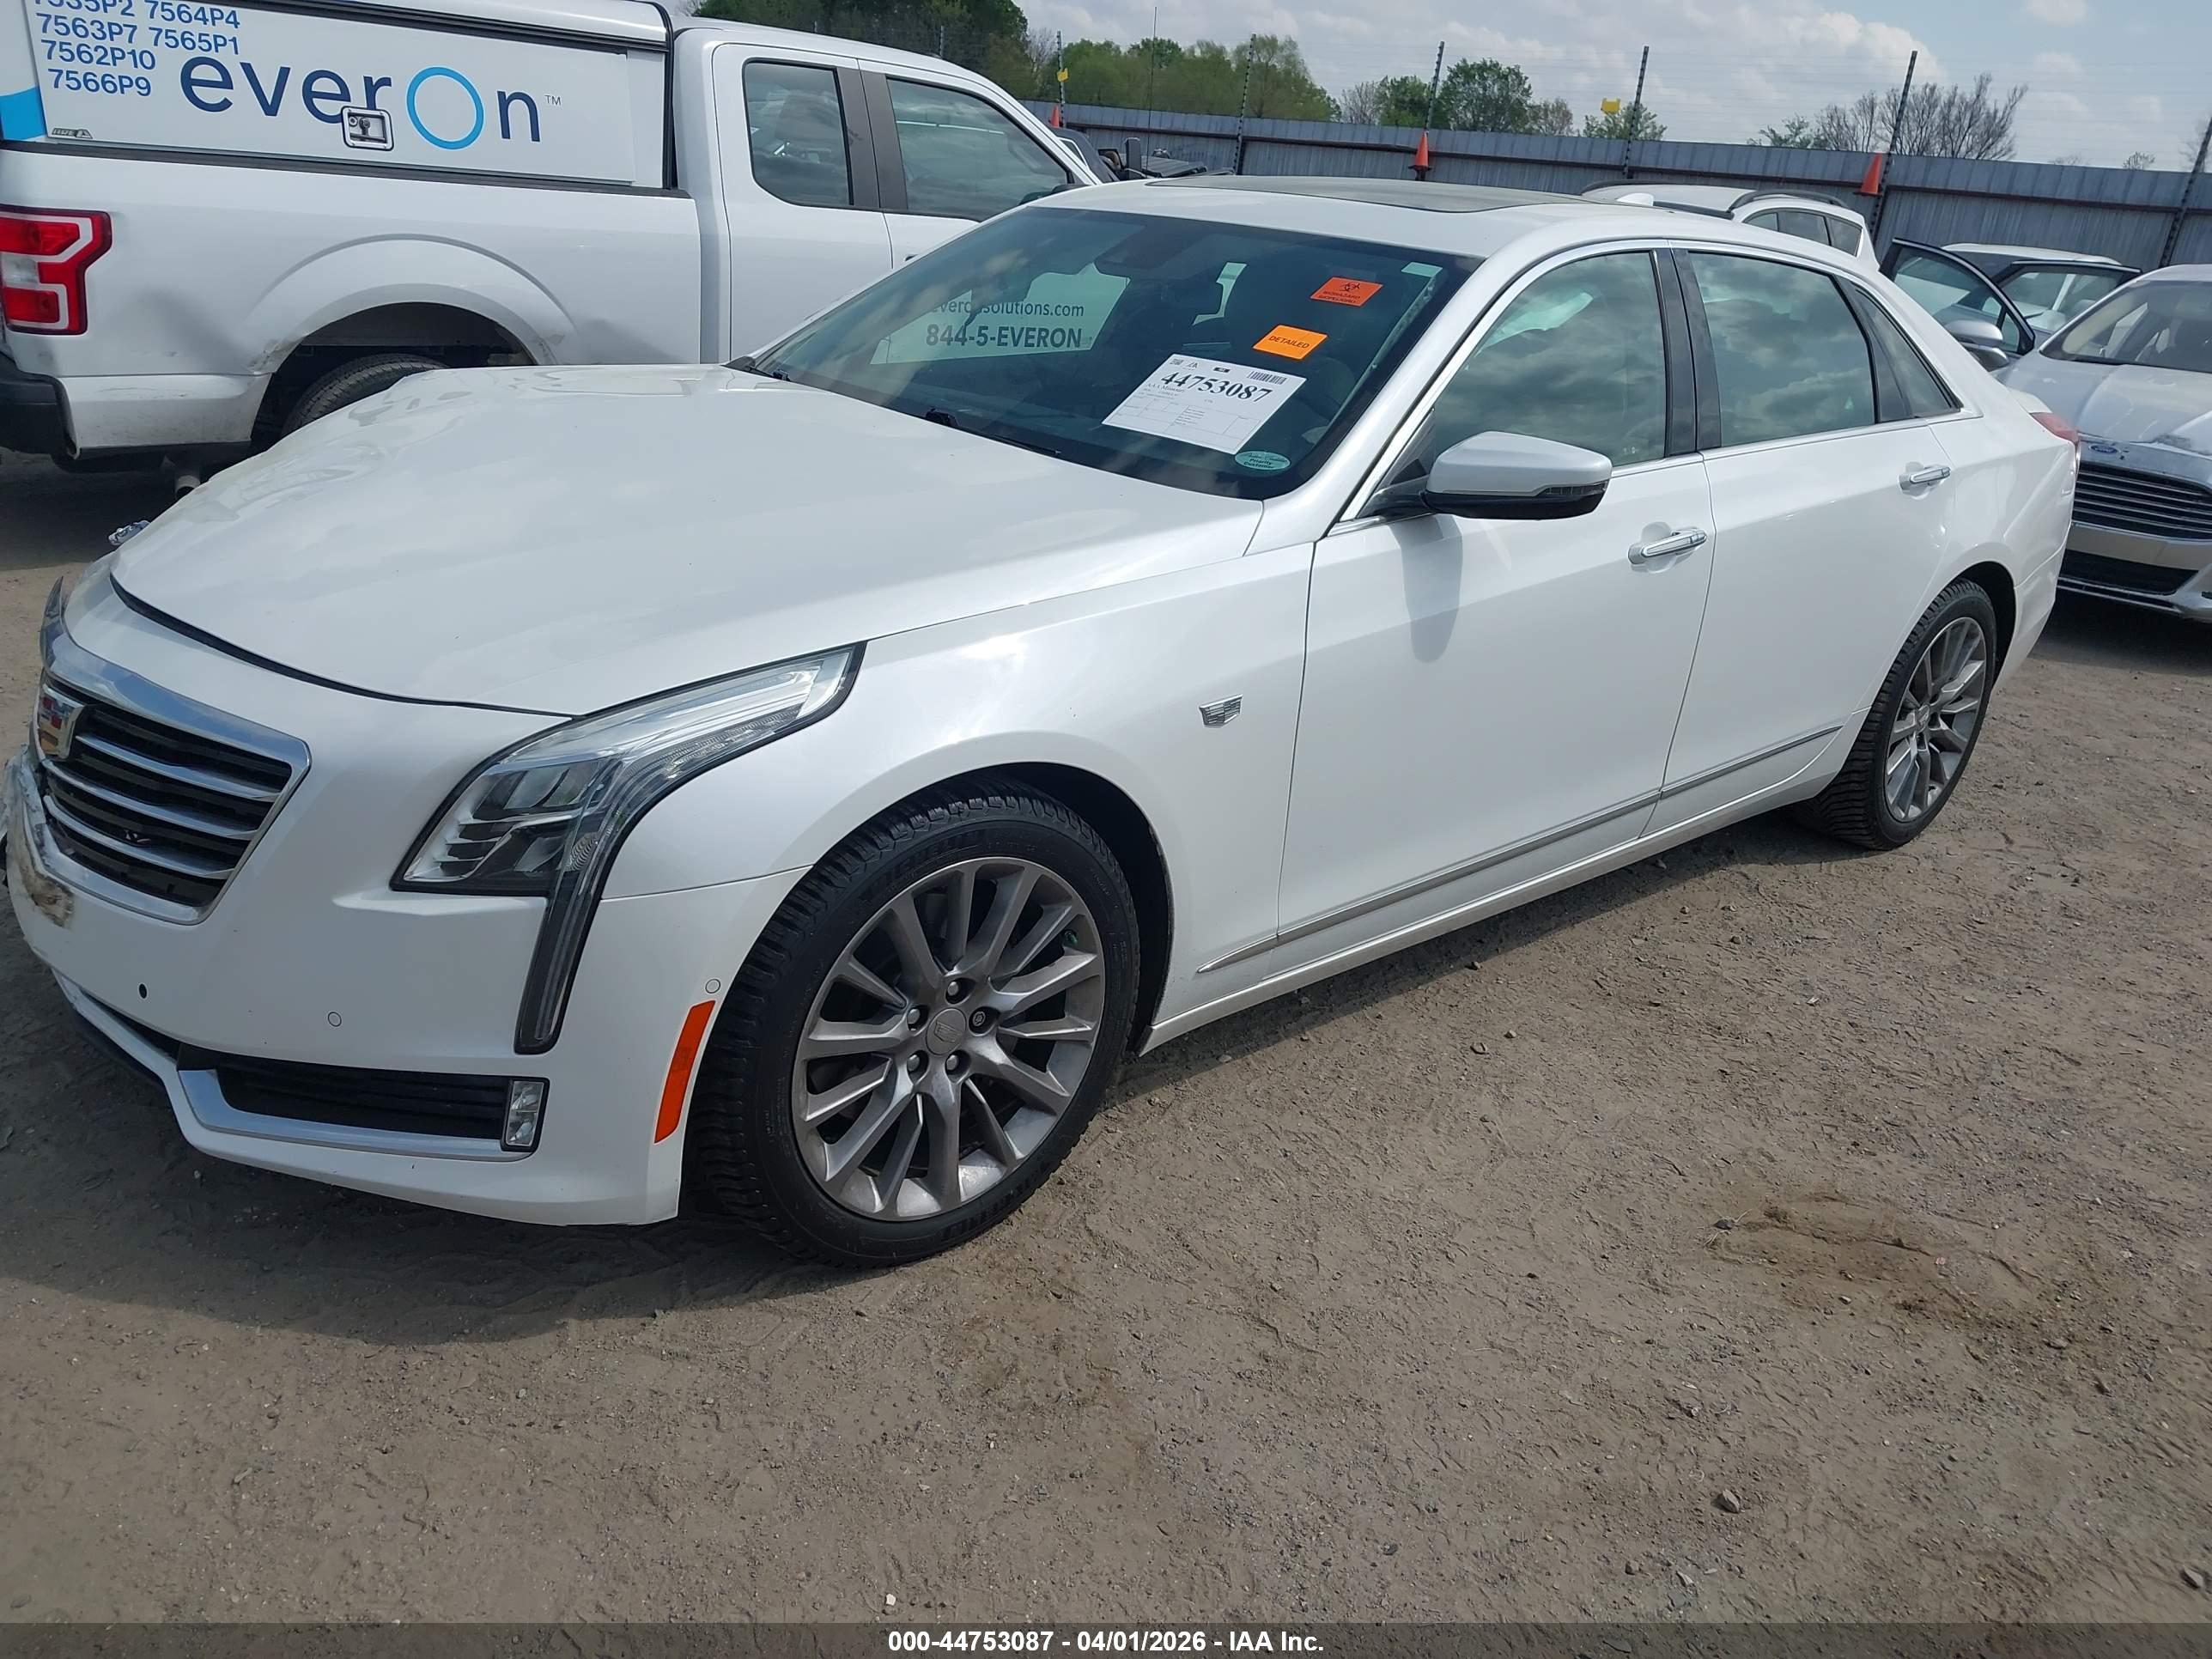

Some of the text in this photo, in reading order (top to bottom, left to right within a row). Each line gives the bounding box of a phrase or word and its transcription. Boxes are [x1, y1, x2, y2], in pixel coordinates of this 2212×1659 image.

[144, 0, 240, 28] 7564P4
[36, 12, 239, 55] 7563P7 7565P1
[41, 40, 156, 70] 7562P10
[48, 69, 151, 96] 7566P9
[927, 323, 1082, 348] 844-5-EVERON
[1268, 335, 1310, 349] DETAILED
[1160, 371, 1273, 404] 44753087
